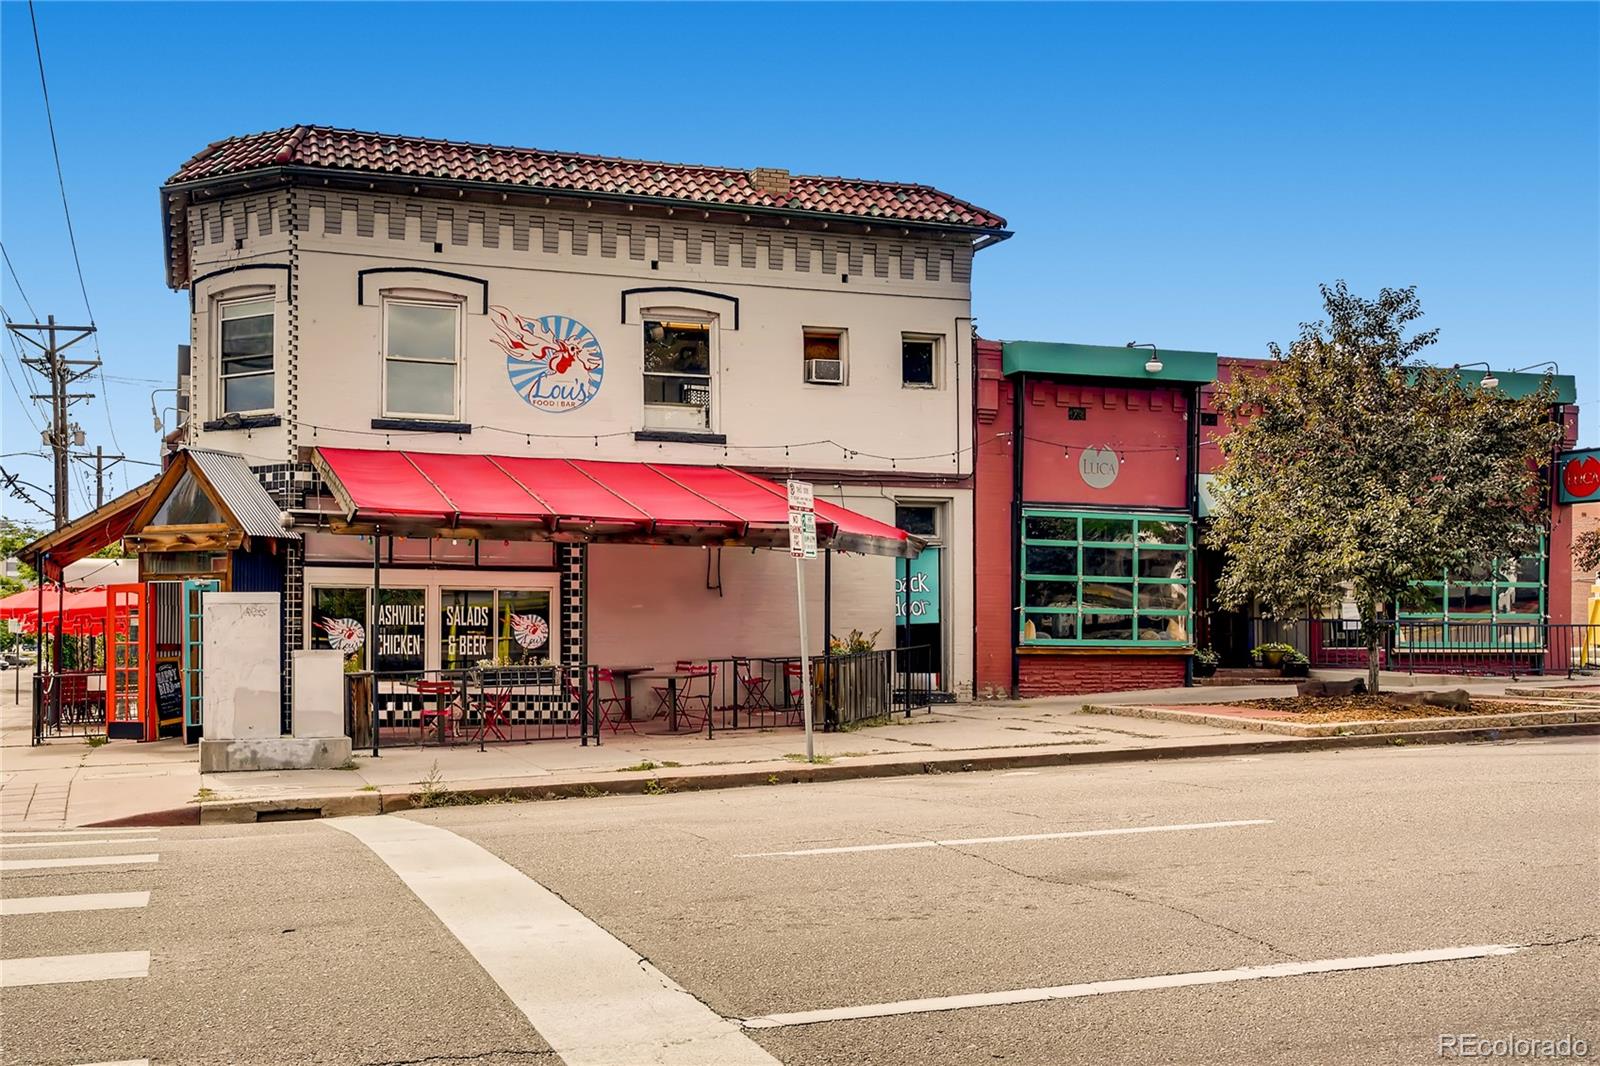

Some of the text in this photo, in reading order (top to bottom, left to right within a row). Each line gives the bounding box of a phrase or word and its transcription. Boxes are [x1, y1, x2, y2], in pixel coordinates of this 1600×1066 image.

[532, 372, 586, 402] Lou's
[1083, 459, 1116, 475] LUCA
[446, 606, 489, 626] SALADS
[448, 635, 487, 655] & BEER
